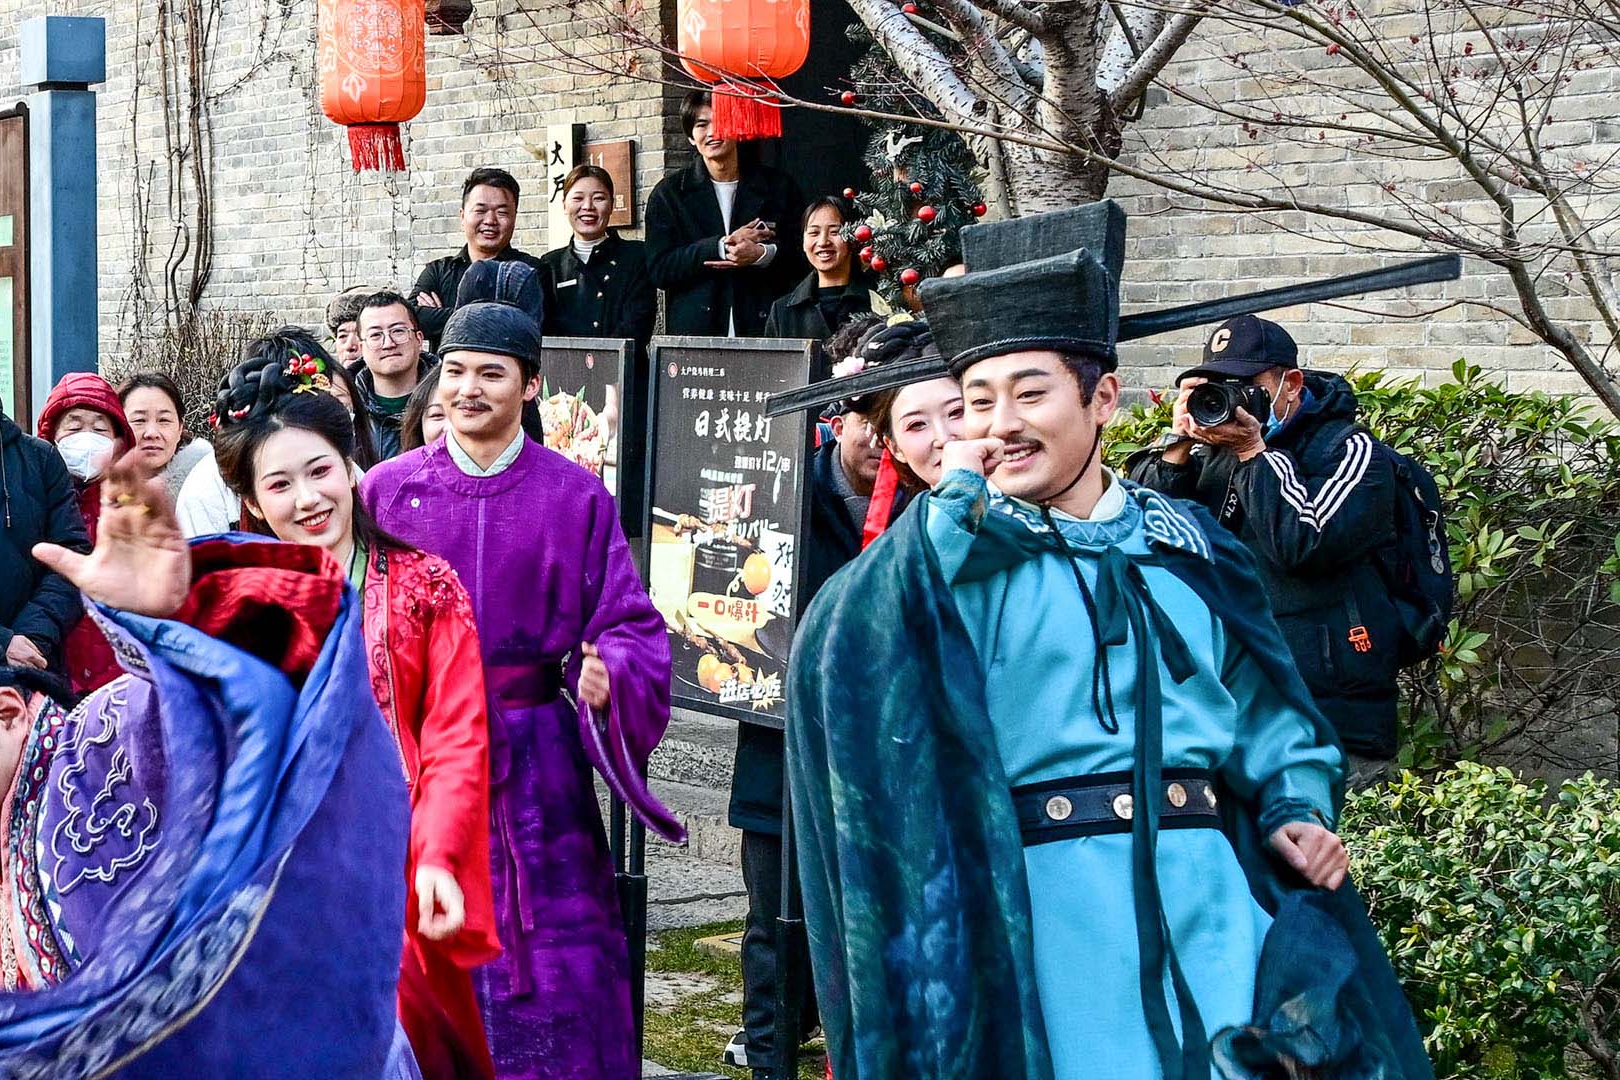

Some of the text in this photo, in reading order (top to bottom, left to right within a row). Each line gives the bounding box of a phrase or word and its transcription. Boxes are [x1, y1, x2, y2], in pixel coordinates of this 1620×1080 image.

[1211, 328, 1232, 353] C
[694, 407, 773, 443] 日式提灯
[697, 599, 760, 624] 一口爆汁
